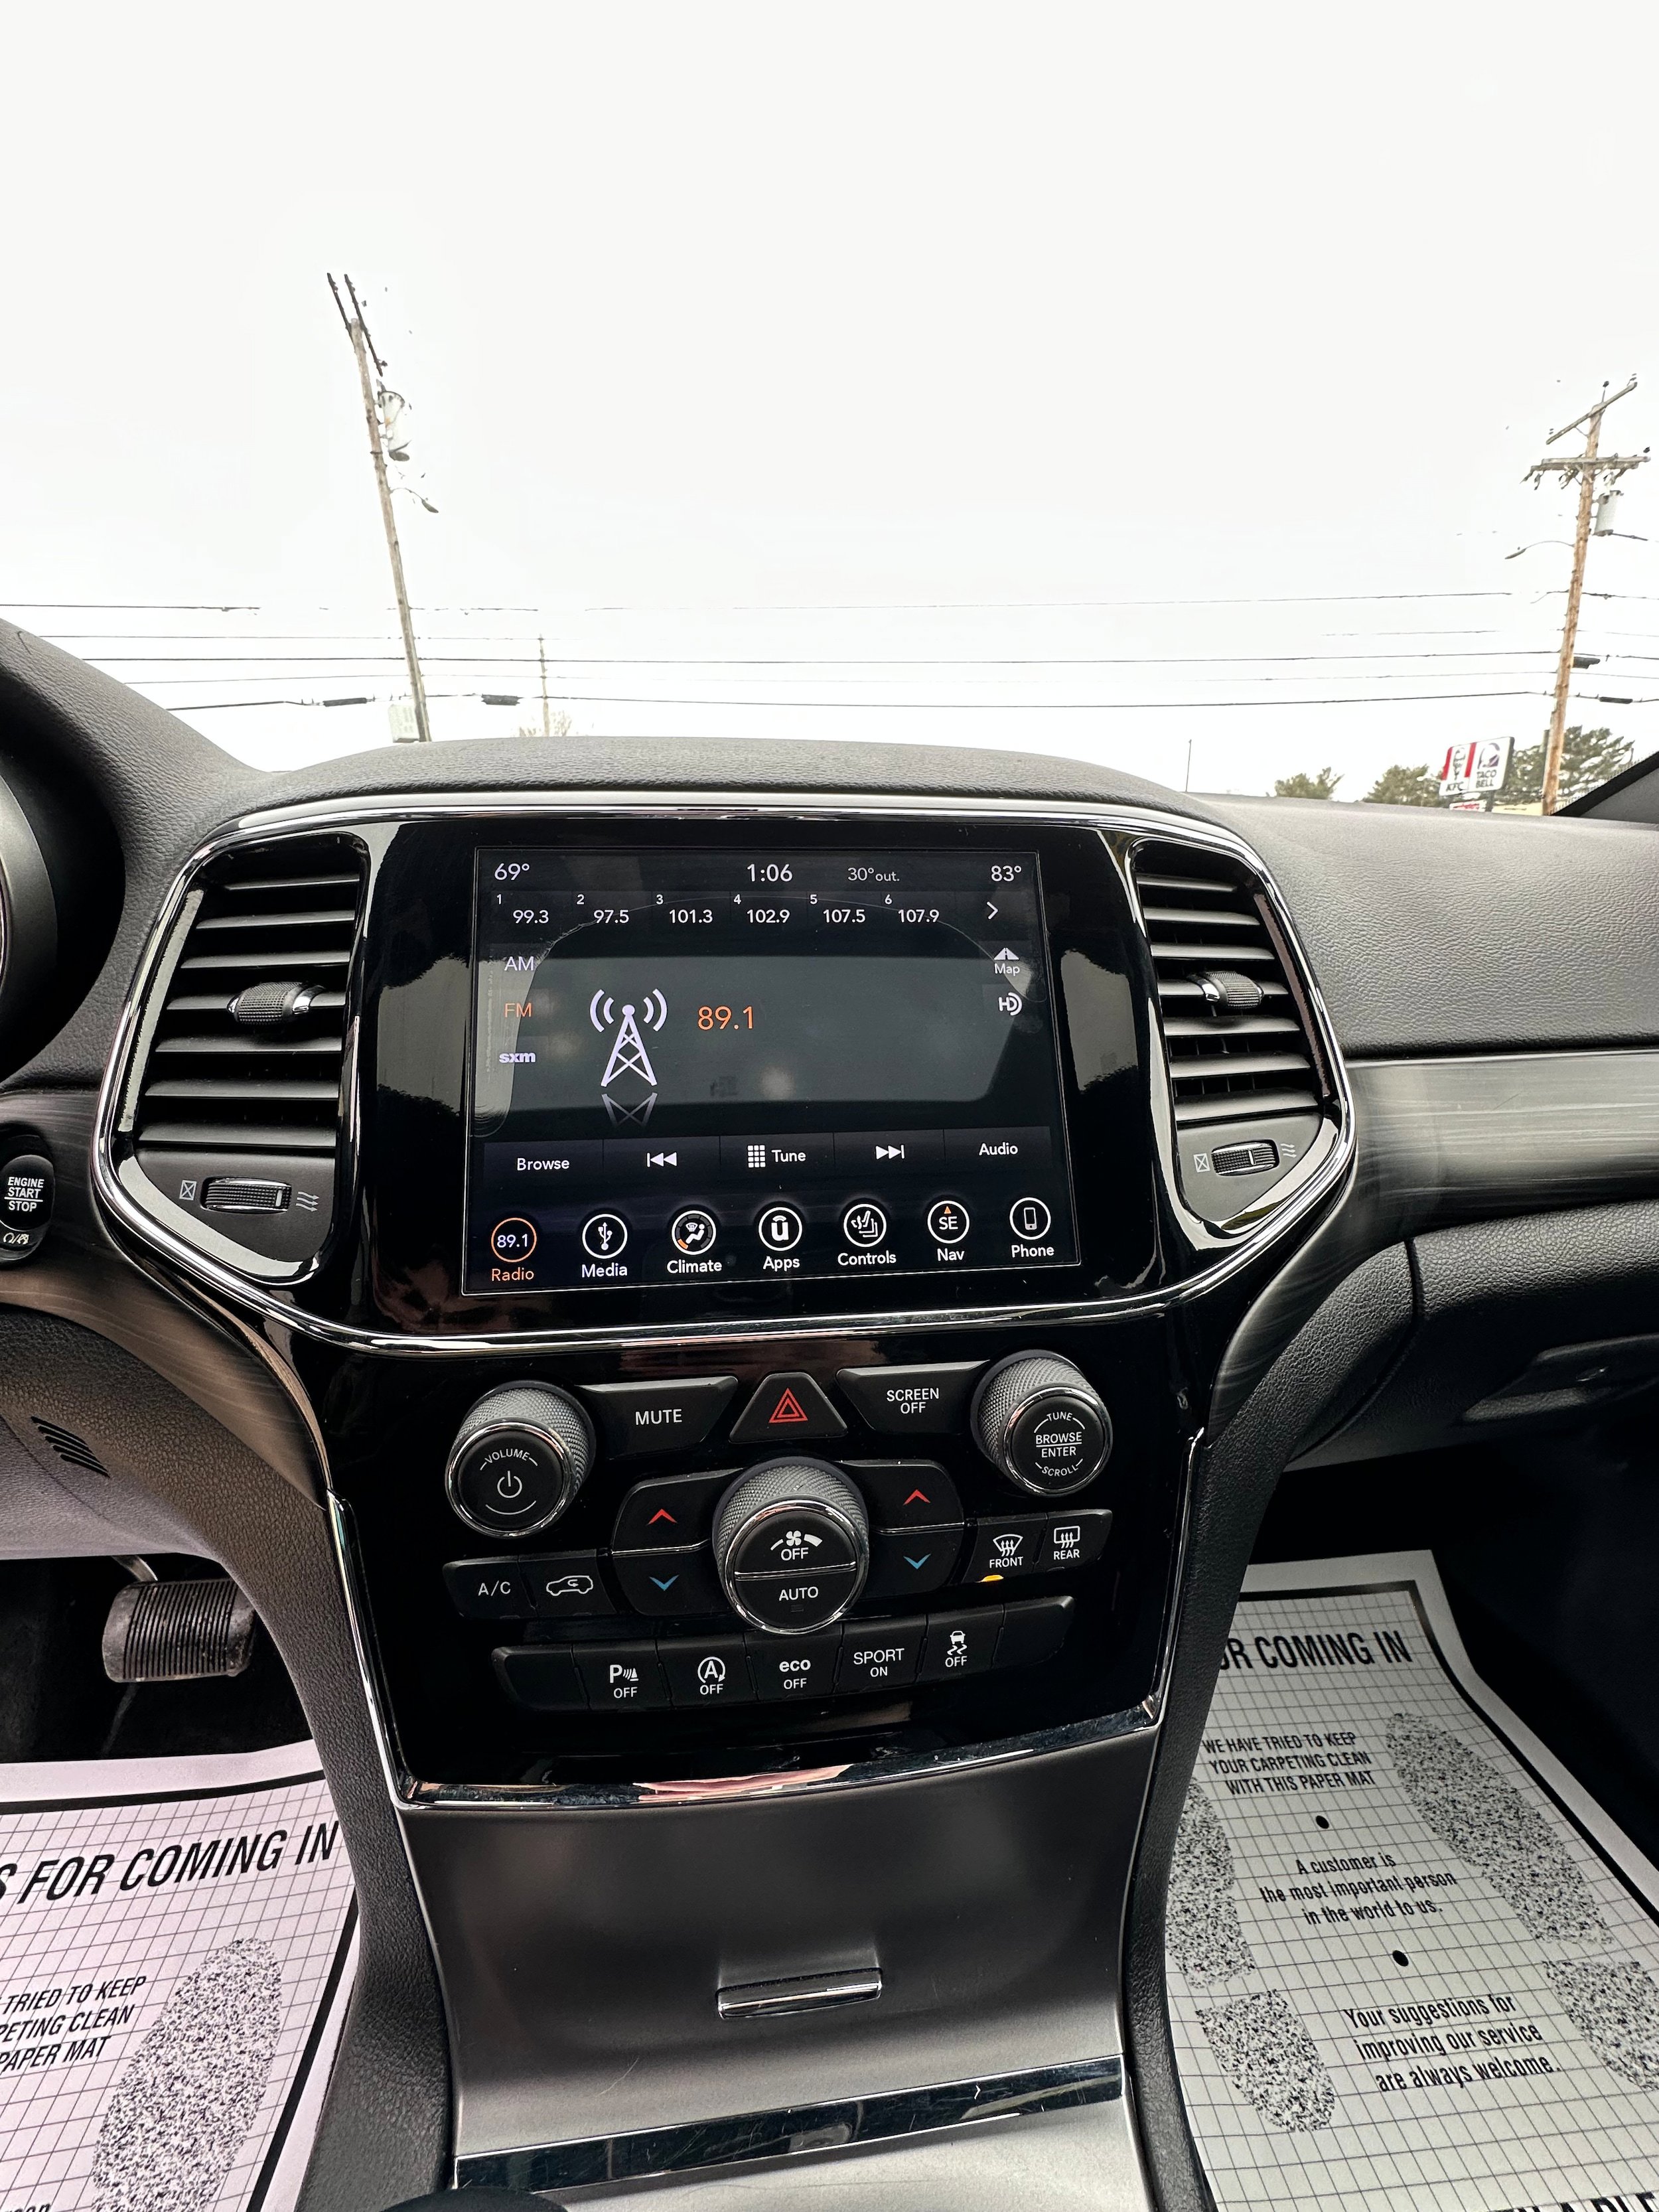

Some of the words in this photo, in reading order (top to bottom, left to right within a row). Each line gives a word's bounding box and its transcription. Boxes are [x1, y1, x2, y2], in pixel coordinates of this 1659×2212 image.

[1477, 770, 1497, 778] TACO
[1445, 781, 1464, 792] KFC
[1475, 780, 1494, 788] BELL
[494, 863, 530, 881] 69°
[747, 863, 793, 883] 1:06
[991, 865, 1022, 882] 83°
[496, 894, 502, 905] 1
[576, 894, 585, 905] 2
[656, 895, 664, 905] 3
[733, 894, 742, 905] 4
[810, 895, 818, 905] 5
[885, 895, 893, 905] 6
[512, 910, 549, 924] 99.3
[593, 910, 630, 924] 97.5
[669, 909, 713, 924] 101.3
[747, 909, 790, 924] 102.9
[823, 909, 866, 924] 107.5
[898, 909, 940, 924] 107.9
[504, 956, 535, 972] AM
[994, 964, 1020, 976] Map
[504, 1003, 533, 1018] FM
[697, 1006, 754, 1030] 89.1
[498, 1052, 536, 1063] sxm
[771, 1149, 806, 1163] Tune
[978, 1142, 1019, 1157] Audio
[516, 1157, 570, 1171] Browse
[7, 1176, 44, 1188] ENGINE
[7, 1187, 41, 1199] START
[8, 1201, 37, 1212] STOP
[938, 1216, 958, 1231] SE
[496, 1234, 528, 1248] 89.1
[937, 1248, 965, 1262] Nav
[1011, 1244, 1054, 1258] Phone
[762, 1256, 800, 1272] Apps
[837, 1251, 897, 1266] Controls
[581, 1263, 628, 1278] Media
[666, 1260, 723, 1274] Climate
[491, 1268, 534, 1282] Radio
[887, 1387, 940, 1402] SCREEN
[900, 1401, 926, 1414] OFF
[635, 1408, 683, 1426] MUTE
[1046, 1411, 1073, 1422] TUNE
[1035, 1431, 1082, 1445] BROWSE
[484, 1447, 530, 1465] VOLUME
[1041, 1447, 1076, 1458] ENTER
[1041, 1464, 1079, 1477] SCROLL
[781, 1547, 809, 1561] OFF
[1053, 1548, 1080, 1561] REAR
[989, 1556, 1024, 1569] FRONT
[478, 1580, 511, 1596] A/C
[778, 1586, 819, 1601] AUTO
[1254, 1633, 1376, 1668] COMING
[1373, 1630, 1413, 1664] IN
[853, 1647, 904, 1666] SPORT
[944, 1655, 968, 1668] OFF
[778, 1659, 811, 1672] eco
[870, 1665, 889, 1678] ON
[699, 1684, 724, 1696] OFF
[783, 1678, 807, 1690] OFF
[613, 1687, 638, 1699] OFF
[1202, 1739, 1226, 1754] WE
[1226, 1737, 1263, 1753] HAVE
[1262, 1735, 1303, 1750] TRIED
[1303, 1733, 1324, 1748] TO
[1324, 1732, 1356, 1747] KEEP
[1209, 1759, 1250, 1775] YOUR
[1250, 1753, 1327, 1773] CARPETING
[1327, 1751, 1372, 1767] CLEAN
[1225, 1778, 1266, 1795] WITH
[1265, 1775, 1298, 1791] THIS
[1298, 1772, 1344, 1791] PAPER
[1344, 1770, 1376, 1786] MAT
[17, 1854, 115, 1905] FOR
[119, 1829, 288, 1891] COMING
[295, 1820, 340, 1866] IN
[1295, 1860, 1309, 1875] A
[1311, 1855, 1378, 1874] customer
[1378, 1852, 1396, 1868] is
[1259, 1886, 1287, 1903] the
[1289, 1882, 1329, 1900] most
[1328, 1876, 1404, 1899] important
[1404, 1872, 1457, 1893] person
[1301, 1908, 1321, 1925] in
[1321, 1906, 1349, 1923] the
[1350, 1900, 1396, 1920] world
[1396, 1899, 1415, 1915] to
[1415, 1899, 1443, 1915] us.
[3, 1988, 62, 2014] TRIED
[66, 1983, 94, 2006] TO
[95, 1976, 147, 2001] KEEP
[68, 2004, 135, 2032] CLEAN
[1343, 2009, 1385, 2028] Your
[1388, 1998, 1490, 2026] suggestions
[1487, 1994, 1516, 2014] for
[62, 2035, 112, 2063] MAT
[1354, 2033, 1447, 2062] improving
[1446, 2031, 1477, 2049] our
[1477, 2022, 1543, 2046] service
[1376, 2073, 1407, 2092] are
[1409, 2065, 1473, 2089] always
[1472, 2056, 1561, 2080] welcome.
